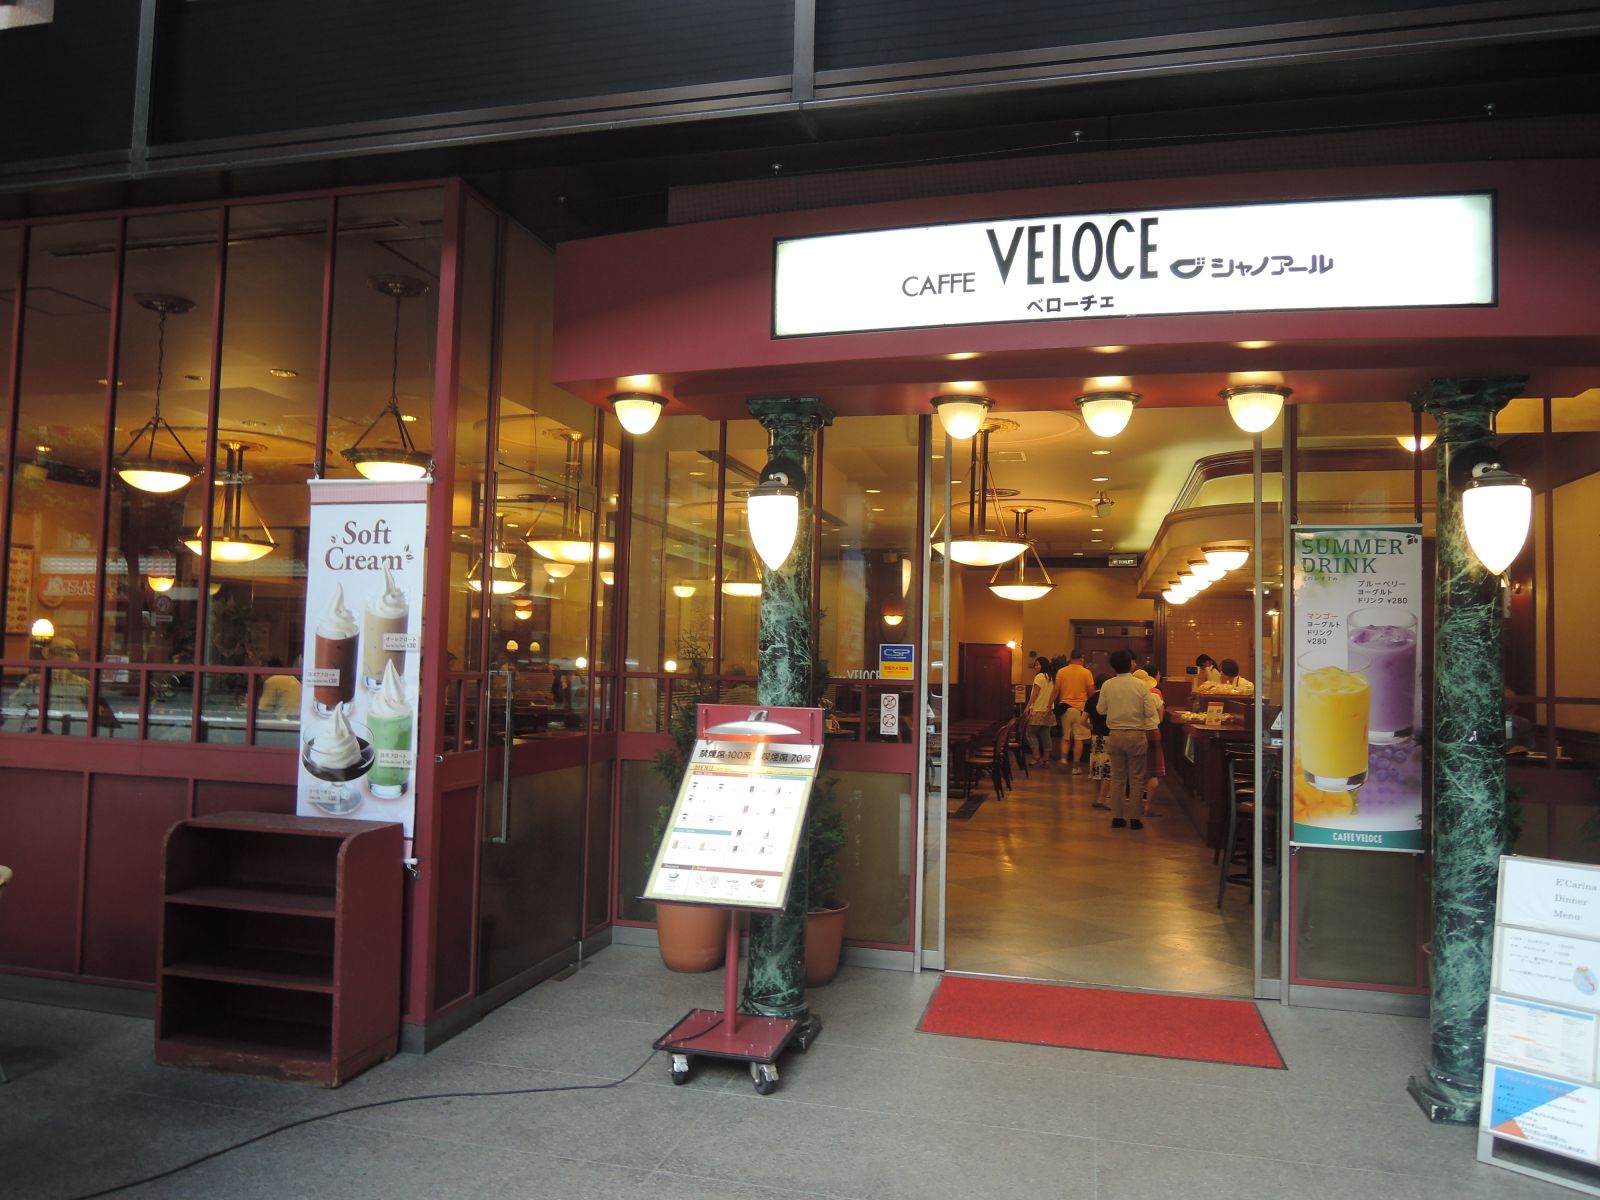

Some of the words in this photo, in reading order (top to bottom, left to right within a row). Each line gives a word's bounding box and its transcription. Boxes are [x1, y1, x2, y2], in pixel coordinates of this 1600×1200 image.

[902, 272, 976, 297] CAFFE
[986, 217, 1159, 286] VELOCE
[1211, 254, 1334, 278] シャノアール
[1026, 294, 1115, 313] ベローチェ
[342, 519, 392, 545] Soft
[1302, 538, 1404, 554] SUMMER
[324, 546, 403, 571] Cream
[1303, 557, 1376, 573] DRINK
[1357, 588, 1393, 596] ヨーグルト
[1357, 597, 1384, 605] ドリンク
[1307, 621, 1342, 629] ヨーグルト
[1307, 629, 1333, 637] ドリンク
[1307, 637, 1327, 645] ¥280
[883, 648, 910, 657] CSP
[1332, 832, 1354, 842] CAFFE
[1356, 833, 1382, 843] VELOCE
[1554, 893, 1588, 906] Dinner
[1552, 909, 1581, 921] Menu
